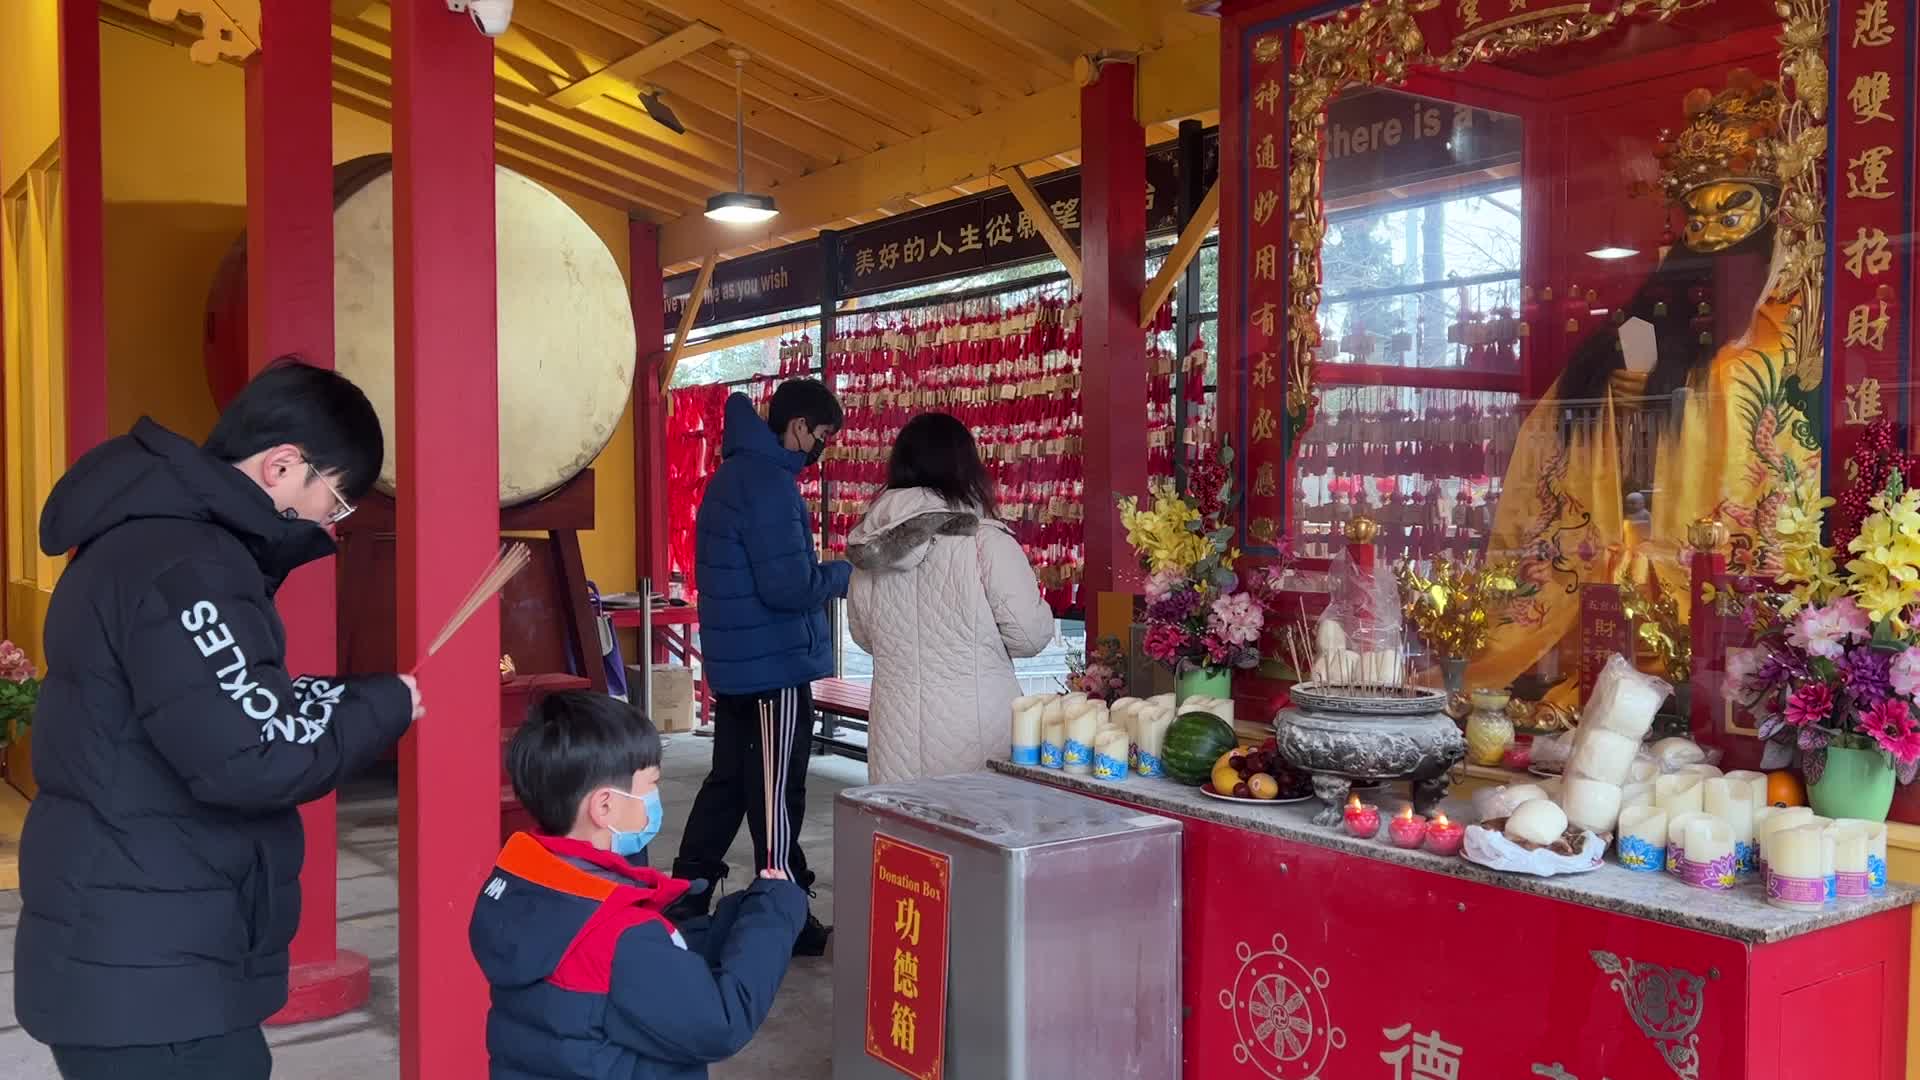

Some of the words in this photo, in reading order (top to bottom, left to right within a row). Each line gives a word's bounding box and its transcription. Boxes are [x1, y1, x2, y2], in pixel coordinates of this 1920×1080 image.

[1414, 103, 1441, 140] is
[722, 285, 737, 298] as
[737, 277, 759, 302] you
[761, 265, 789, 292] wish
[878, 864, 920, 894] Donation
[922, 880, 941, 901] Box
[890, 897, 921, 1055] 功德箱
